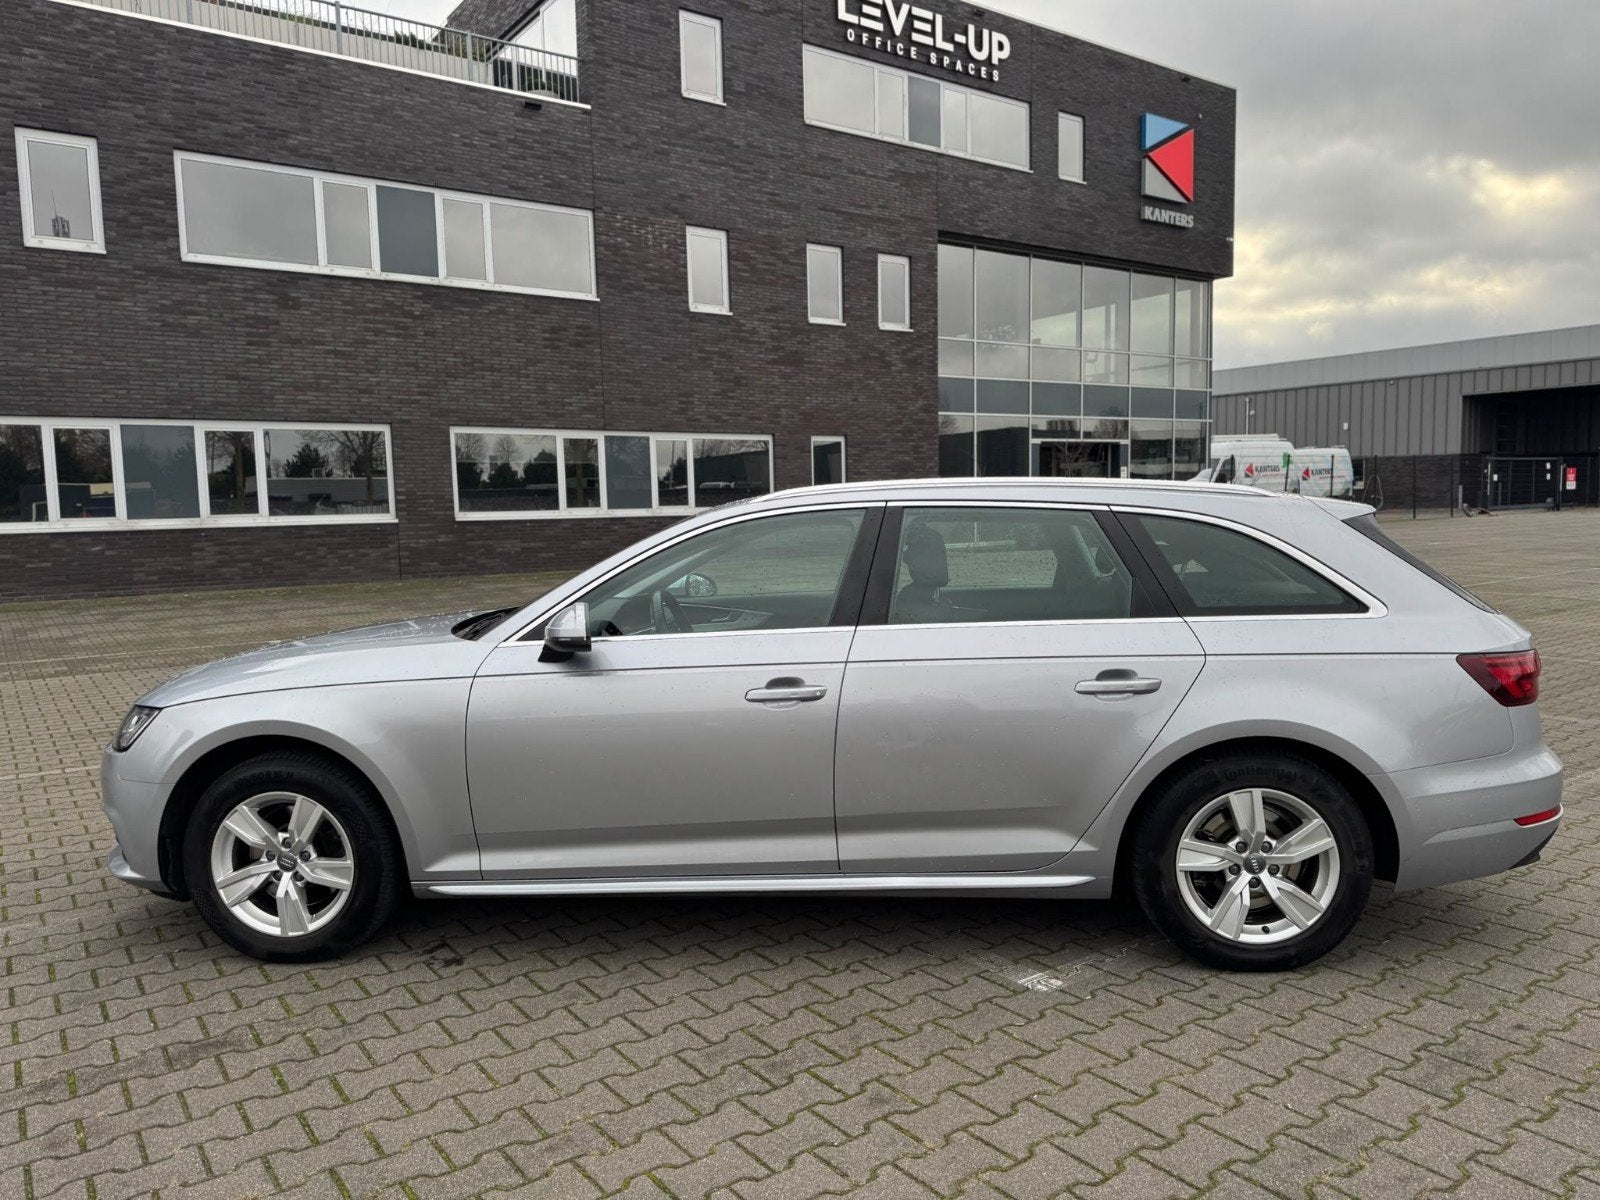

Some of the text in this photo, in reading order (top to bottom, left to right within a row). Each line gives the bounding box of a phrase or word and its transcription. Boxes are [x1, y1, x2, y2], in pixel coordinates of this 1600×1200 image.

[837, 0, 1011, 66] LEVEL-UP
[846, 28, 1000, 82] OFFICE SPACES
[1144, 205, 1195, 228] KANTERS
[1255, 464, 1280, 473] KANTERS
